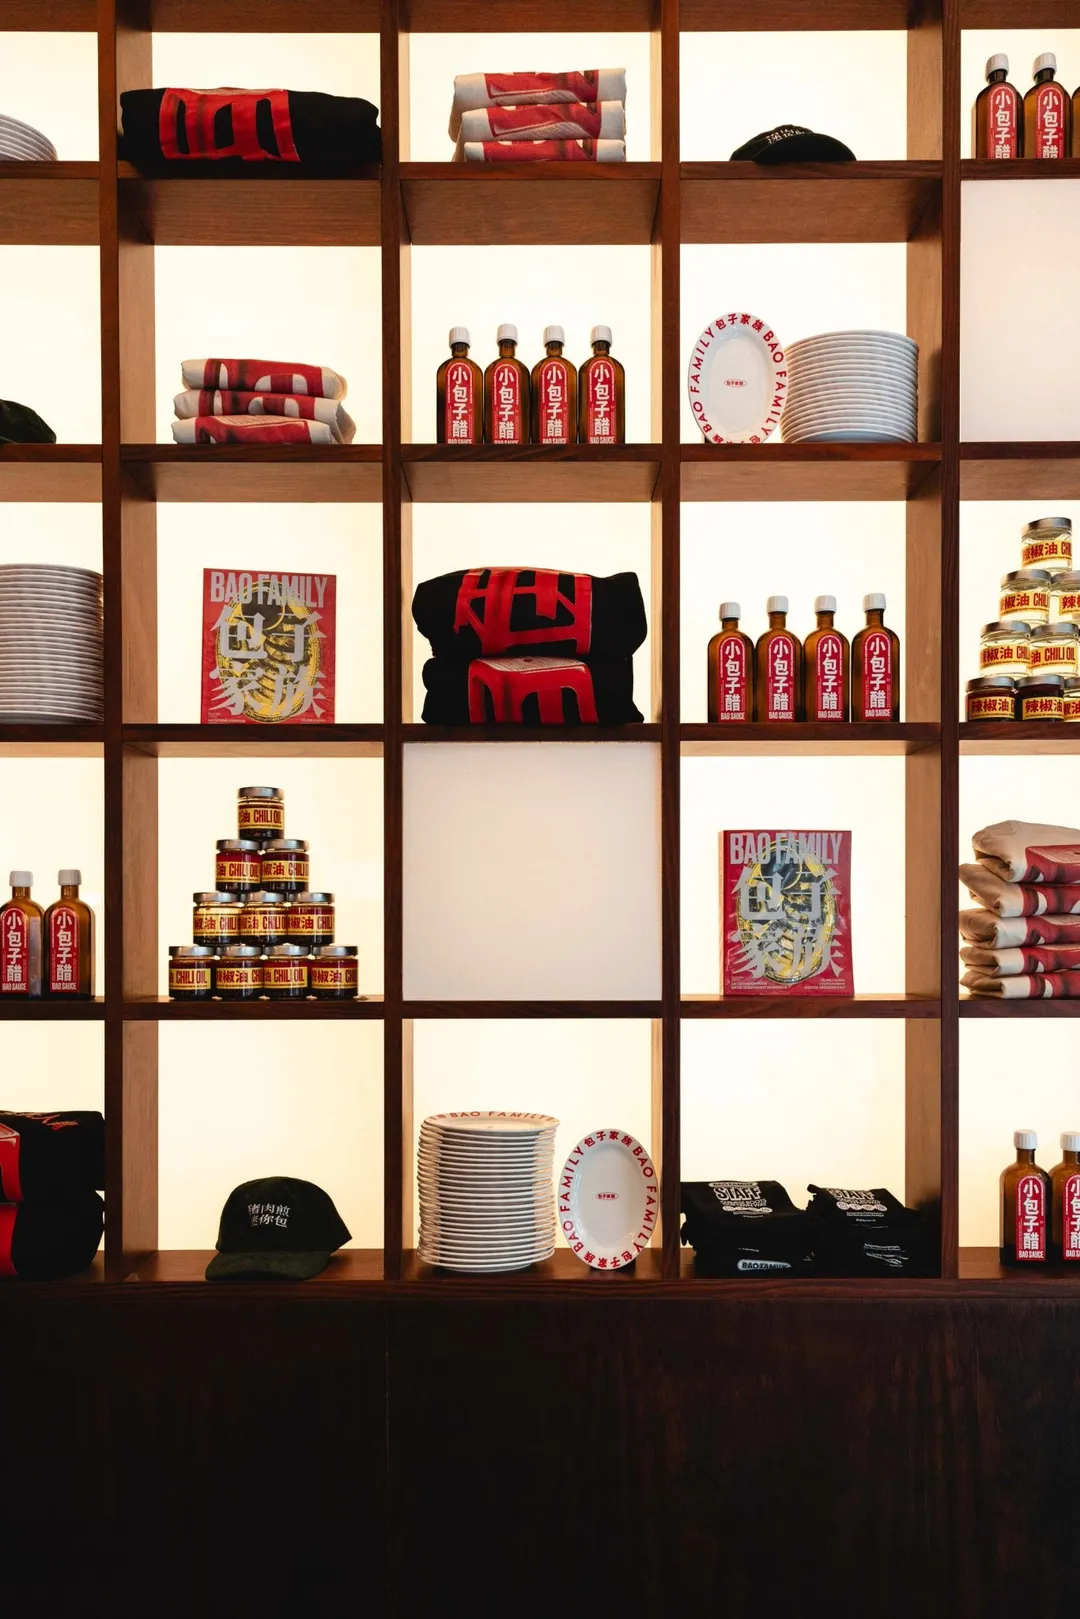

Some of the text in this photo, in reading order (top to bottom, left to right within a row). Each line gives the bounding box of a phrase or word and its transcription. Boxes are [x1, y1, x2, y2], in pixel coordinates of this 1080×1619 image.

[716, 314, 764, 332] 包子家族
[452, 367, 468, 438] 小包子醋
[499, 368, 514, 439] 小包子醋
[547, 366, 562, 437] 小包子醋
[594, 365, 610, 436] 小包子醋
[690, 328, 714, 433] BAO FAMILY
[762, 331, 787, 435] BAO FAMILY
[210, 572, 327, 608] BAO FAMILY
[725, 642, 740, 712] 小包子醋
[774, 642, 788, 711] 小包子醋
[822, 640, 838, 710] 小包子醋
[870, 638, 886, 709] 小包子醋
[1044, 647, 1064, 661] CHILI
[1066, 647, 1075, 660] OIL
[721, 712, 730, 720] BAO
[769, 711, 793, 720] BAO SAUCE
[818, 711, 827, 719] BAO
[865, 709, 890, 717] BAO SAUCE
[254, 810, 272, 822] CHILI
[229, 863, 248, 876] CHILI
[730, 832, 843, 864] BAO FAMILY
[7, 912, 22, 982] 小包子醋
[57, 912, 72, 982] 小包子醋
[176, 971, 194, 984] CHILI
[196, 971, 207, 983] OIL
[274, 969, 292, 982] CHILI
[294, 968, 304, 981] OIL
[584, 1130, 633, 1147] 包子家族
[560, 1146, 584, 1252] BAO FAMILY
[632, 1146, 656, 1252] BAO FAMILY
[713, 1186, 761, 1201] STAFF
[1023, 1180, 1039, 1250] 小包子醋
[584, 1250, 632, 1268] 包子家族
